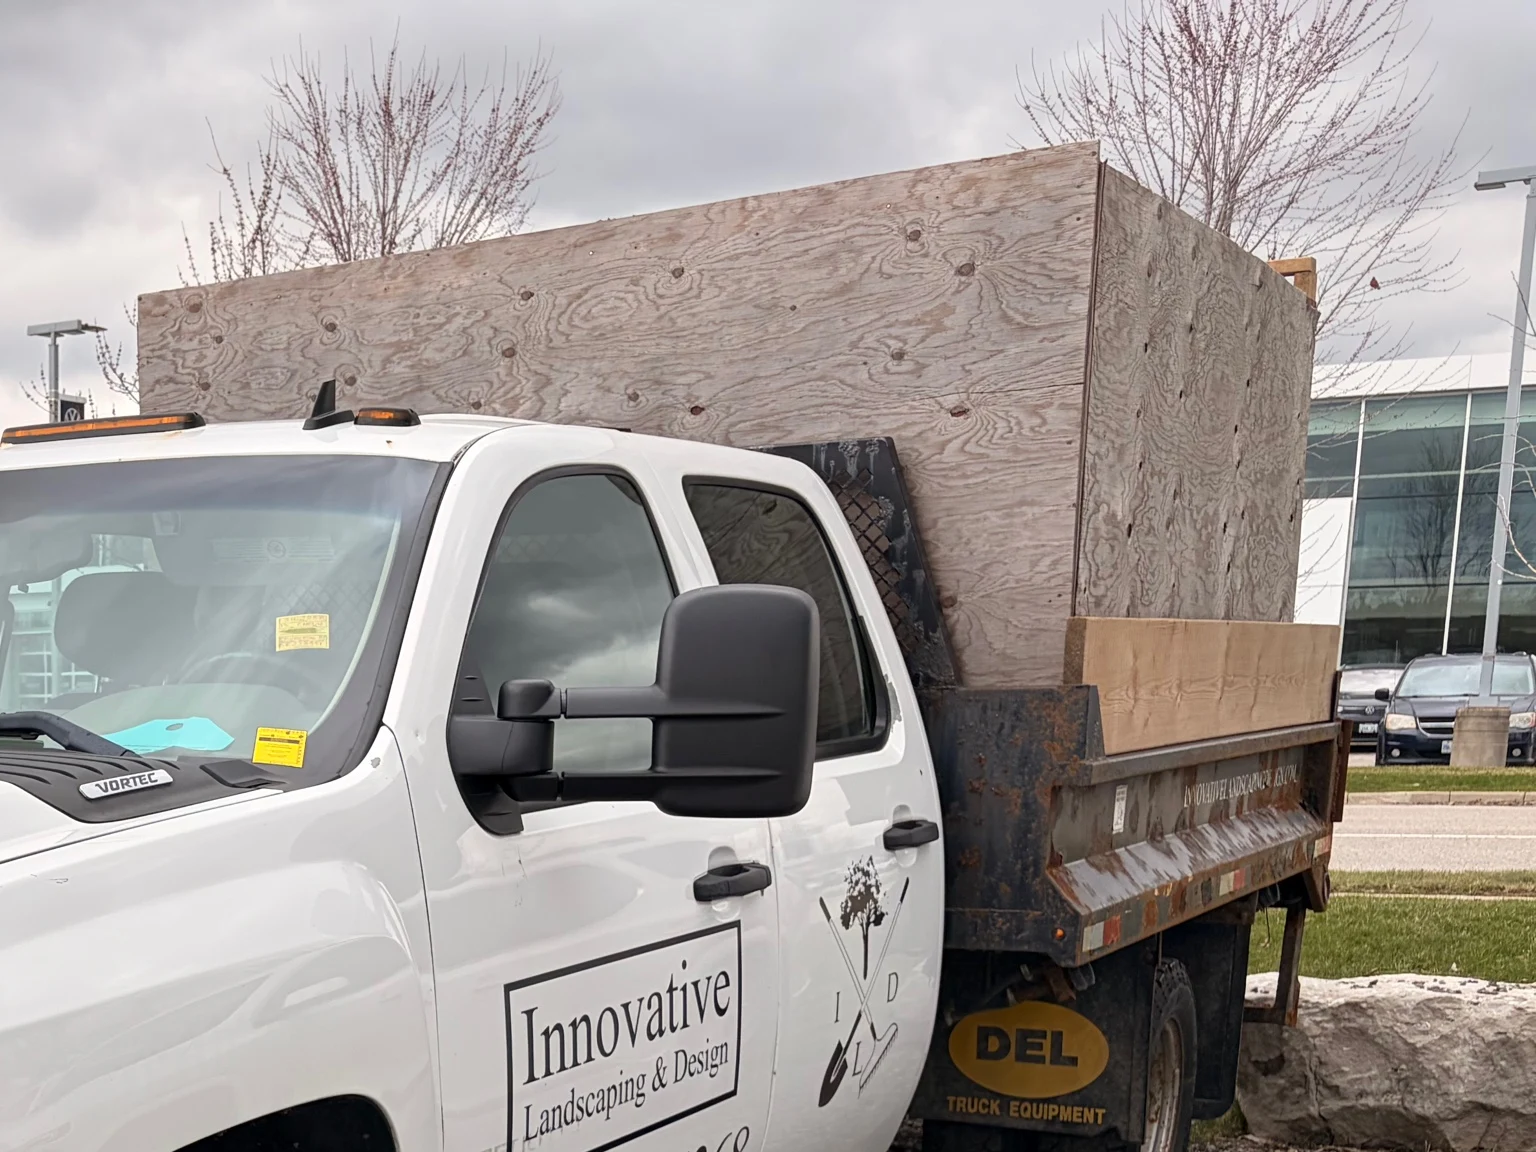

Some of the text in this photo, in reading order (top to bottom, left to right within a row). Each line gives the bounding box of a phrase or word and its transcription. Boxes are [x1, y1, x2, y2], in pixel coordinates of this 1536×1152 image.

[95, 772, 158, 794] VORTEC
[887, 971, 899, 1004] D
[521, 959, 731, 1086] Innovative
[976, 1025, 1079, 1068] DEL
[523, 1038, 730, 1142] Landscaping & Design
[946, 1096, 1107, 1125] TRUCK EQUIPMENT
